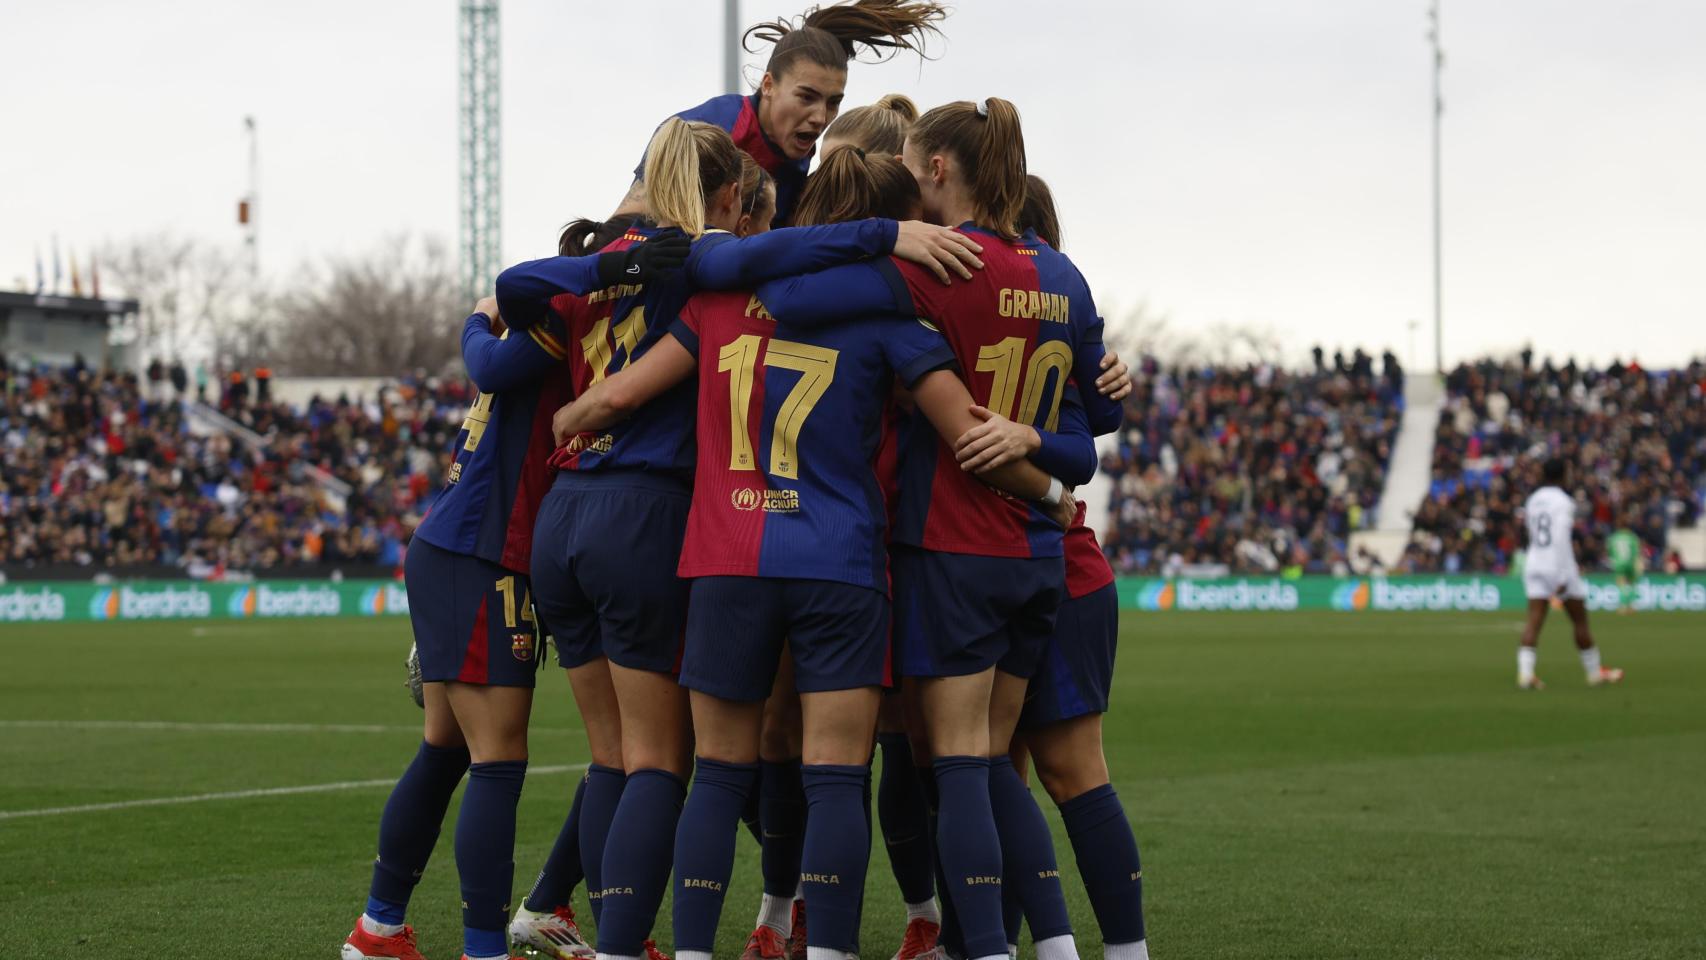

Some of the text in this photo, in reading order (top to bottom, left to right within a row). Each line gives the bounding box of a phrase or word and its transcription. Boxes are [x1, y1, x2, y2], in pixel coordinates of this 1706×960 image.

[998, 288, 1069, 325] GRAHAM
[975, 336, 1073, 434] 10
[718, 334, 840, 480] 17
[761, 499, 799, 509] ACNUR
[763, 489, 799, 499] UNHCR
